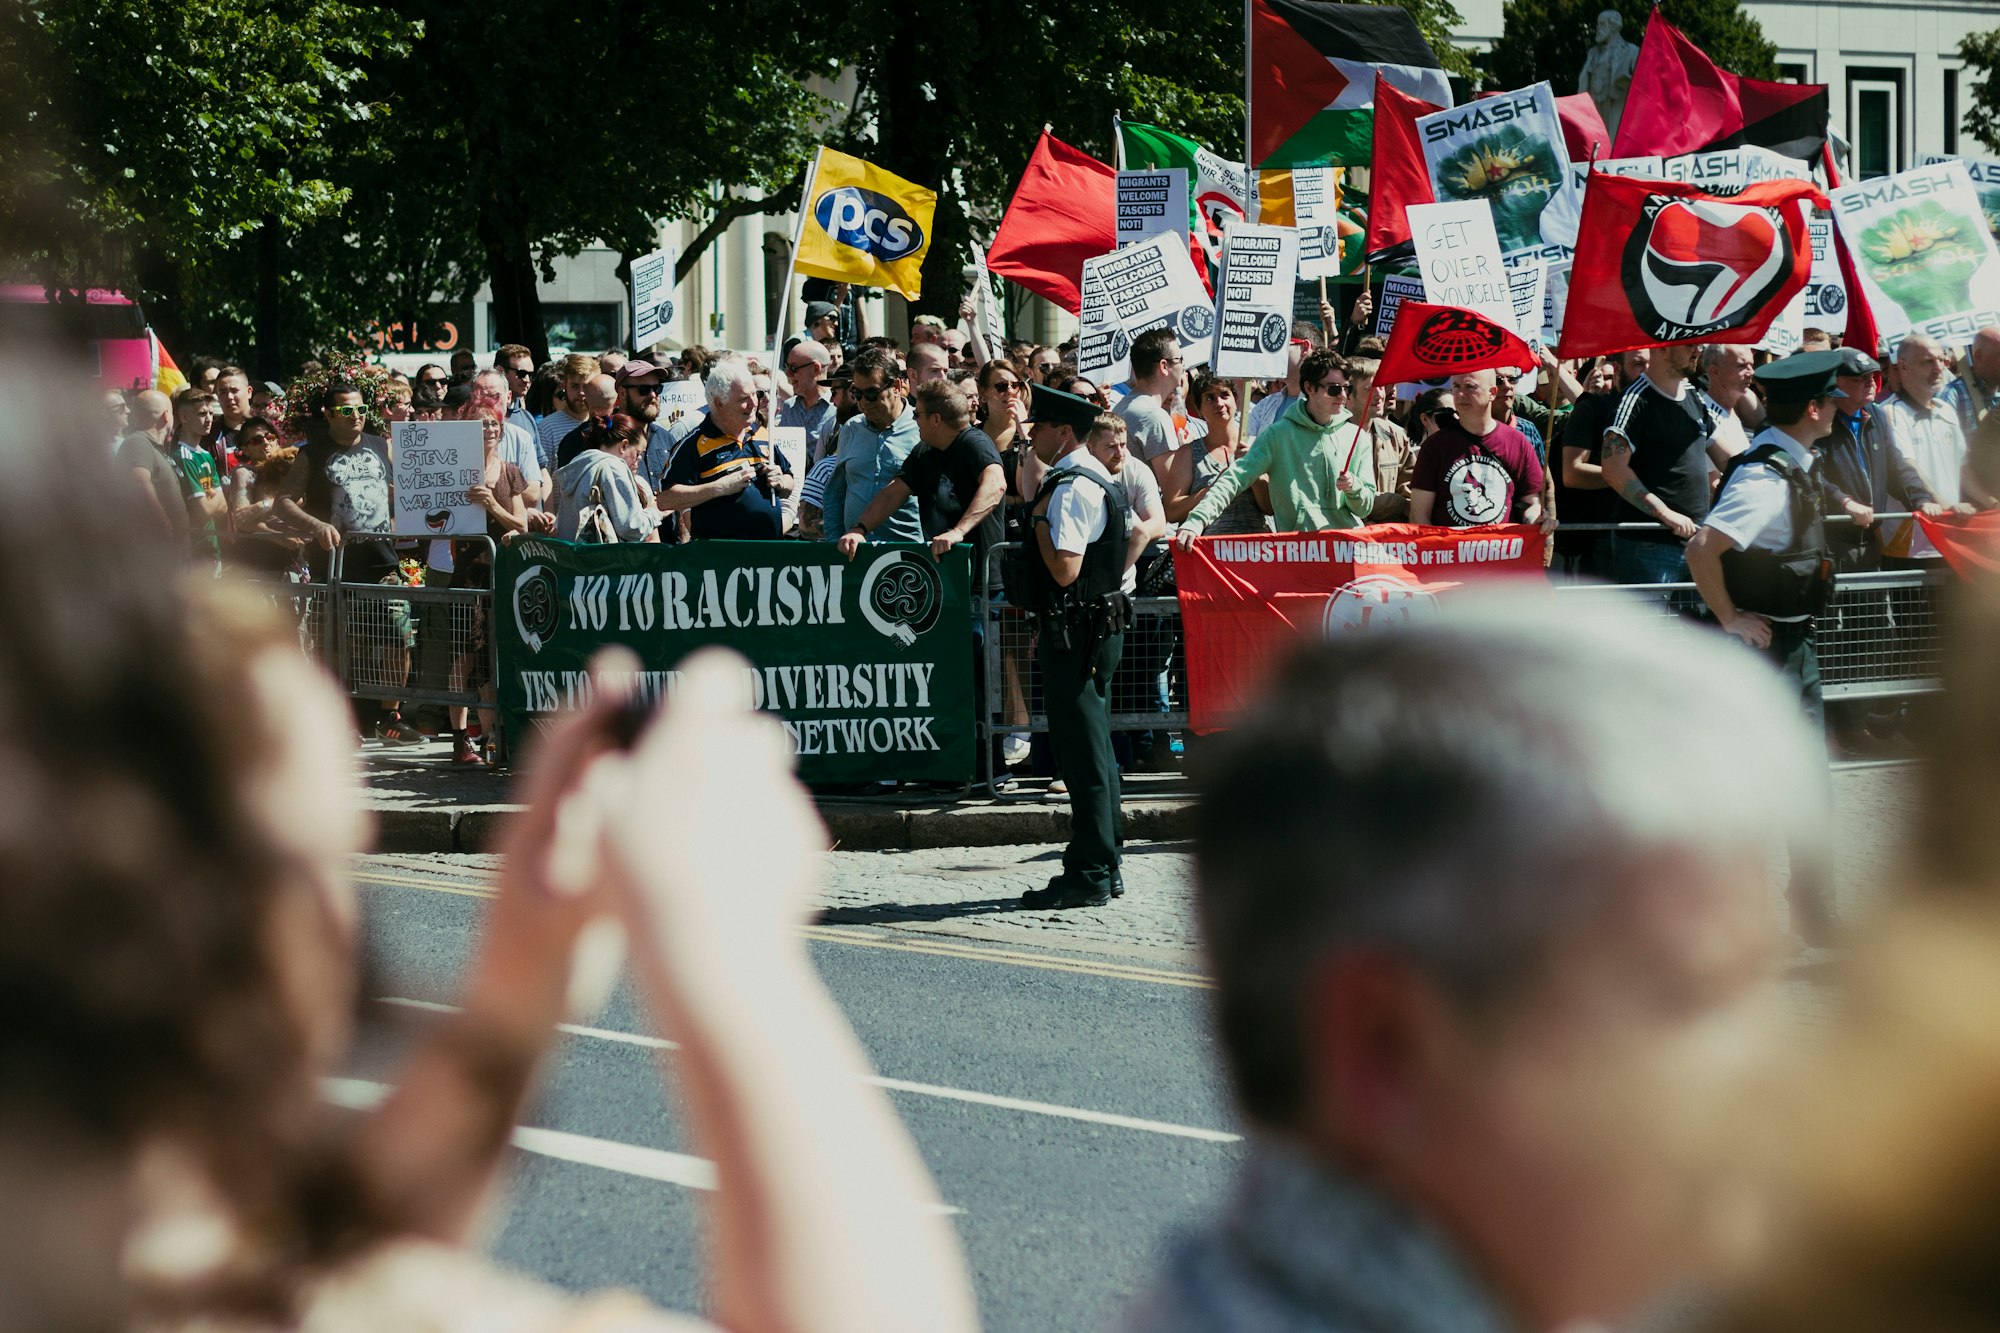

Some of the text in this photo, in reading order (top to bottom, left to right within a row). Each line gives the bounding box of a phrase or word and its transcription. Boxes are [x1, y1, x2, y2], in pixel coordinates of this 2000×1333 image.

[1425, 96, 1538, 143] SMASH
[1120, 177, 1168, 187] MIGRANTS
[1120, 191, 1166, 201] WELCOME
[1841, 173, 1954, 214] SMASH
[1120, 205, 1163, 215] FASCISTS
[828, 194, 912, 251] pcs
[1120, 219, 1141, 229] NOT!
[1427, 220, 1471, 249] GET
[1232, 238, 1279, 250] MIGRANTS
[1099, 247, 1159, 278] MIGRANTS
[1231, 255, 1276, 266] WELCOME
[1105, 262, 1164, 290] WELCOME
[1229, 271, 1272, 283] FASCISTS
[1432, 256, 1490, 283] OVER
[1111, 276, 1166, 303] FASCISTS
[1227, 288, 1250, 299] NOT!
[1387, 281, 1424, 297] MIGRA
[1433, 283, 1507, 306] YOURSELF
[1083, 311, 1102, 323] NOT!
[1119, 299, 1146, 318] NOT!
[1226, 312, 1256, 323] UNITED
[1224, 325, 1259, 336] AGAINST
[1083, 334, 1107, 347] UNITED
[1223, 338, 1255, 348] RACISM
[1081, 345, 1110, 358] AGAINST
[1081, 356, 1108, 369] RACISM
[401, 449, 458, 470] STEVE
[460, 469, 480, 485] HE
[400, 491, 472, 511] WAS HERE
[519, 541, 557, 562] WARN
[1213, 538, 1523, 565] INDUSTRIAL WORKERS OF THE WORLD
[569, 565, 844, 631] NO TO RACISM
[521, 671, 558, 712] YES
[561, 671, 593, 711] TO
[747, 663, 934, 711] DIVERSITY
[781, 717, 941, 754] NETWORK
